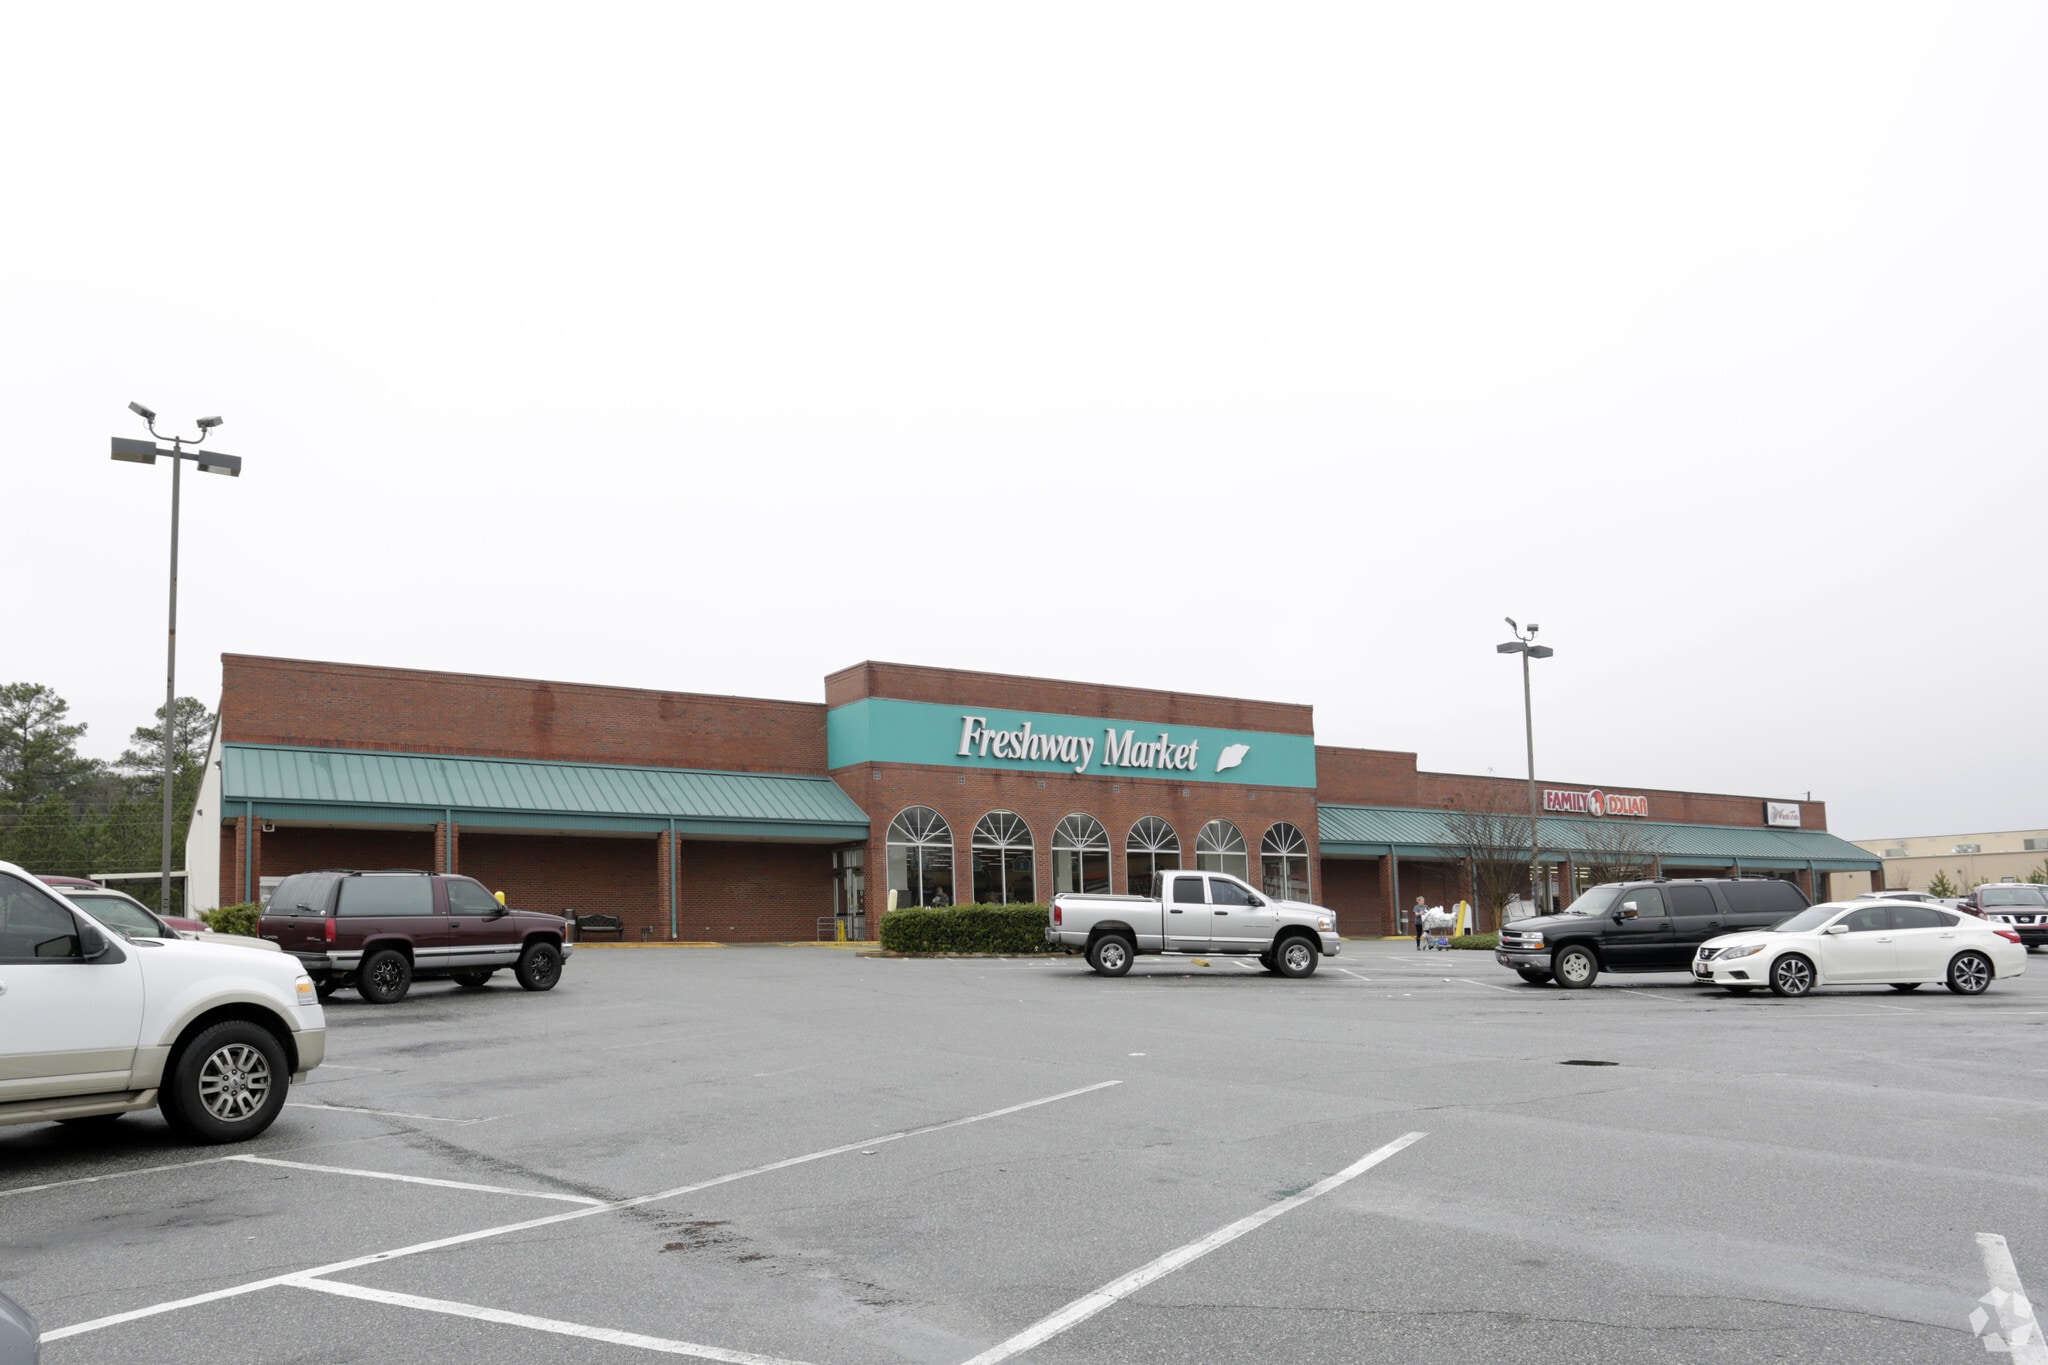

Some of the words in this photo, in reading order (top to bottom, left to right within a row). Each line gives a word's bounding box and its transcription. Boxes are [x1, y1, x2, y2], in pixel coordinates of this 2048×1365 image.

[957, 715, 1095, 774] Freshway
[1102, 728, 1200, 771] Market
[1545, 790, 1589, 812] FAMILY
[1608, 794, 1648, 816] DOLLAR
